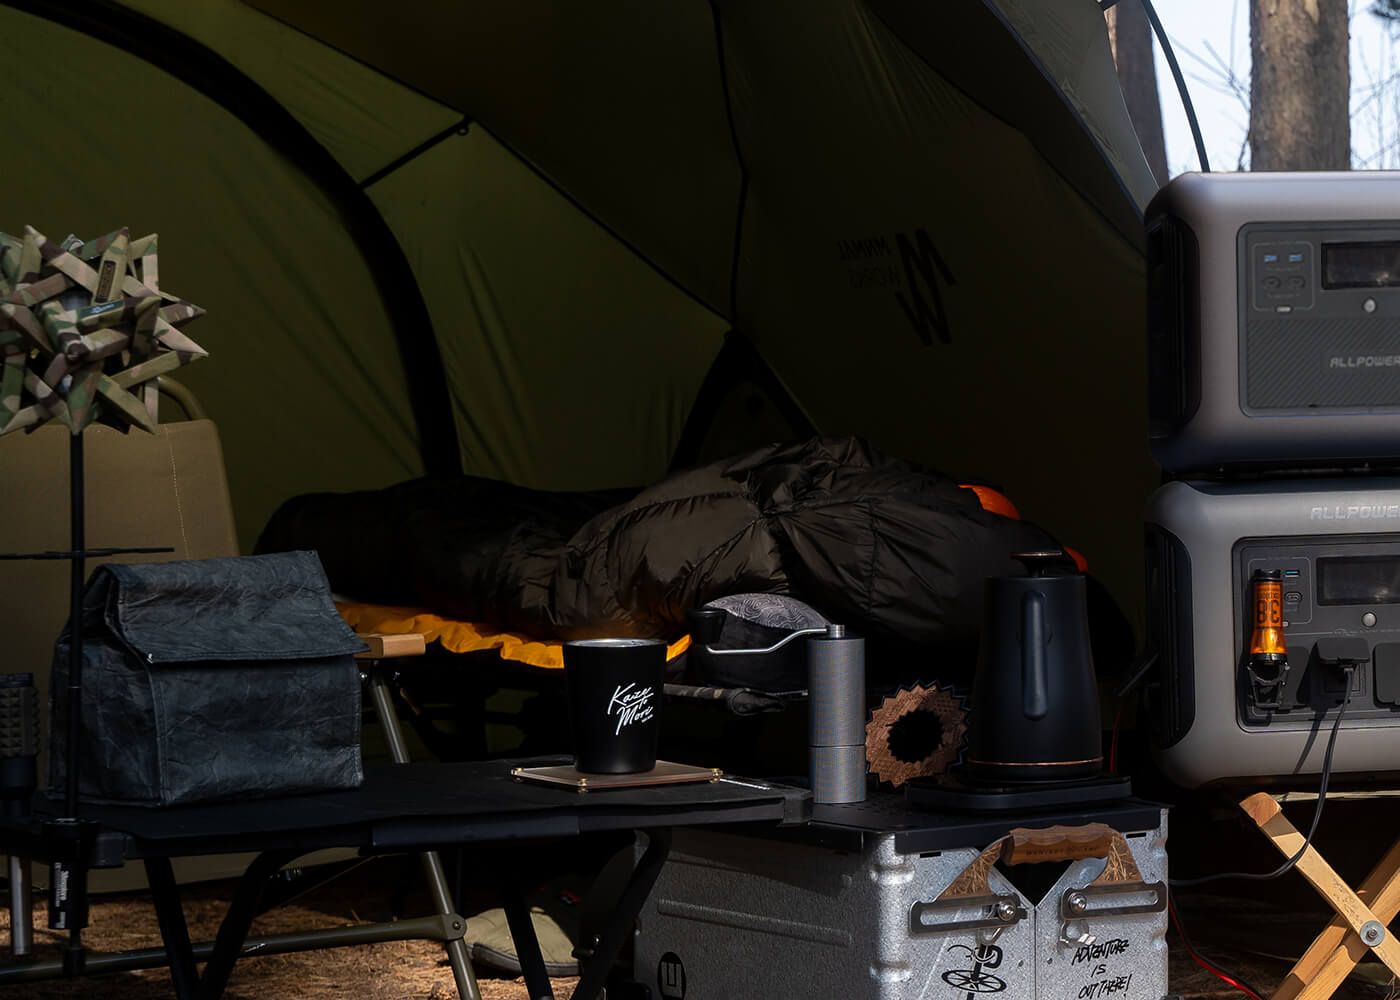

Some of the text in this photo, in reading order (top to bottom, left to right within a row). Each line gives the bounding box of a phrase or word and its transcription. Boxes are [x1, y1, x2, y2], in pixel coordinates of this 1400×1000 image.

[1071, 938, 1130, 966] ADVENTURE
[1090, 964, 1107, 978] IS
[1078, 974, 1133, 1000] OUT THERE!
